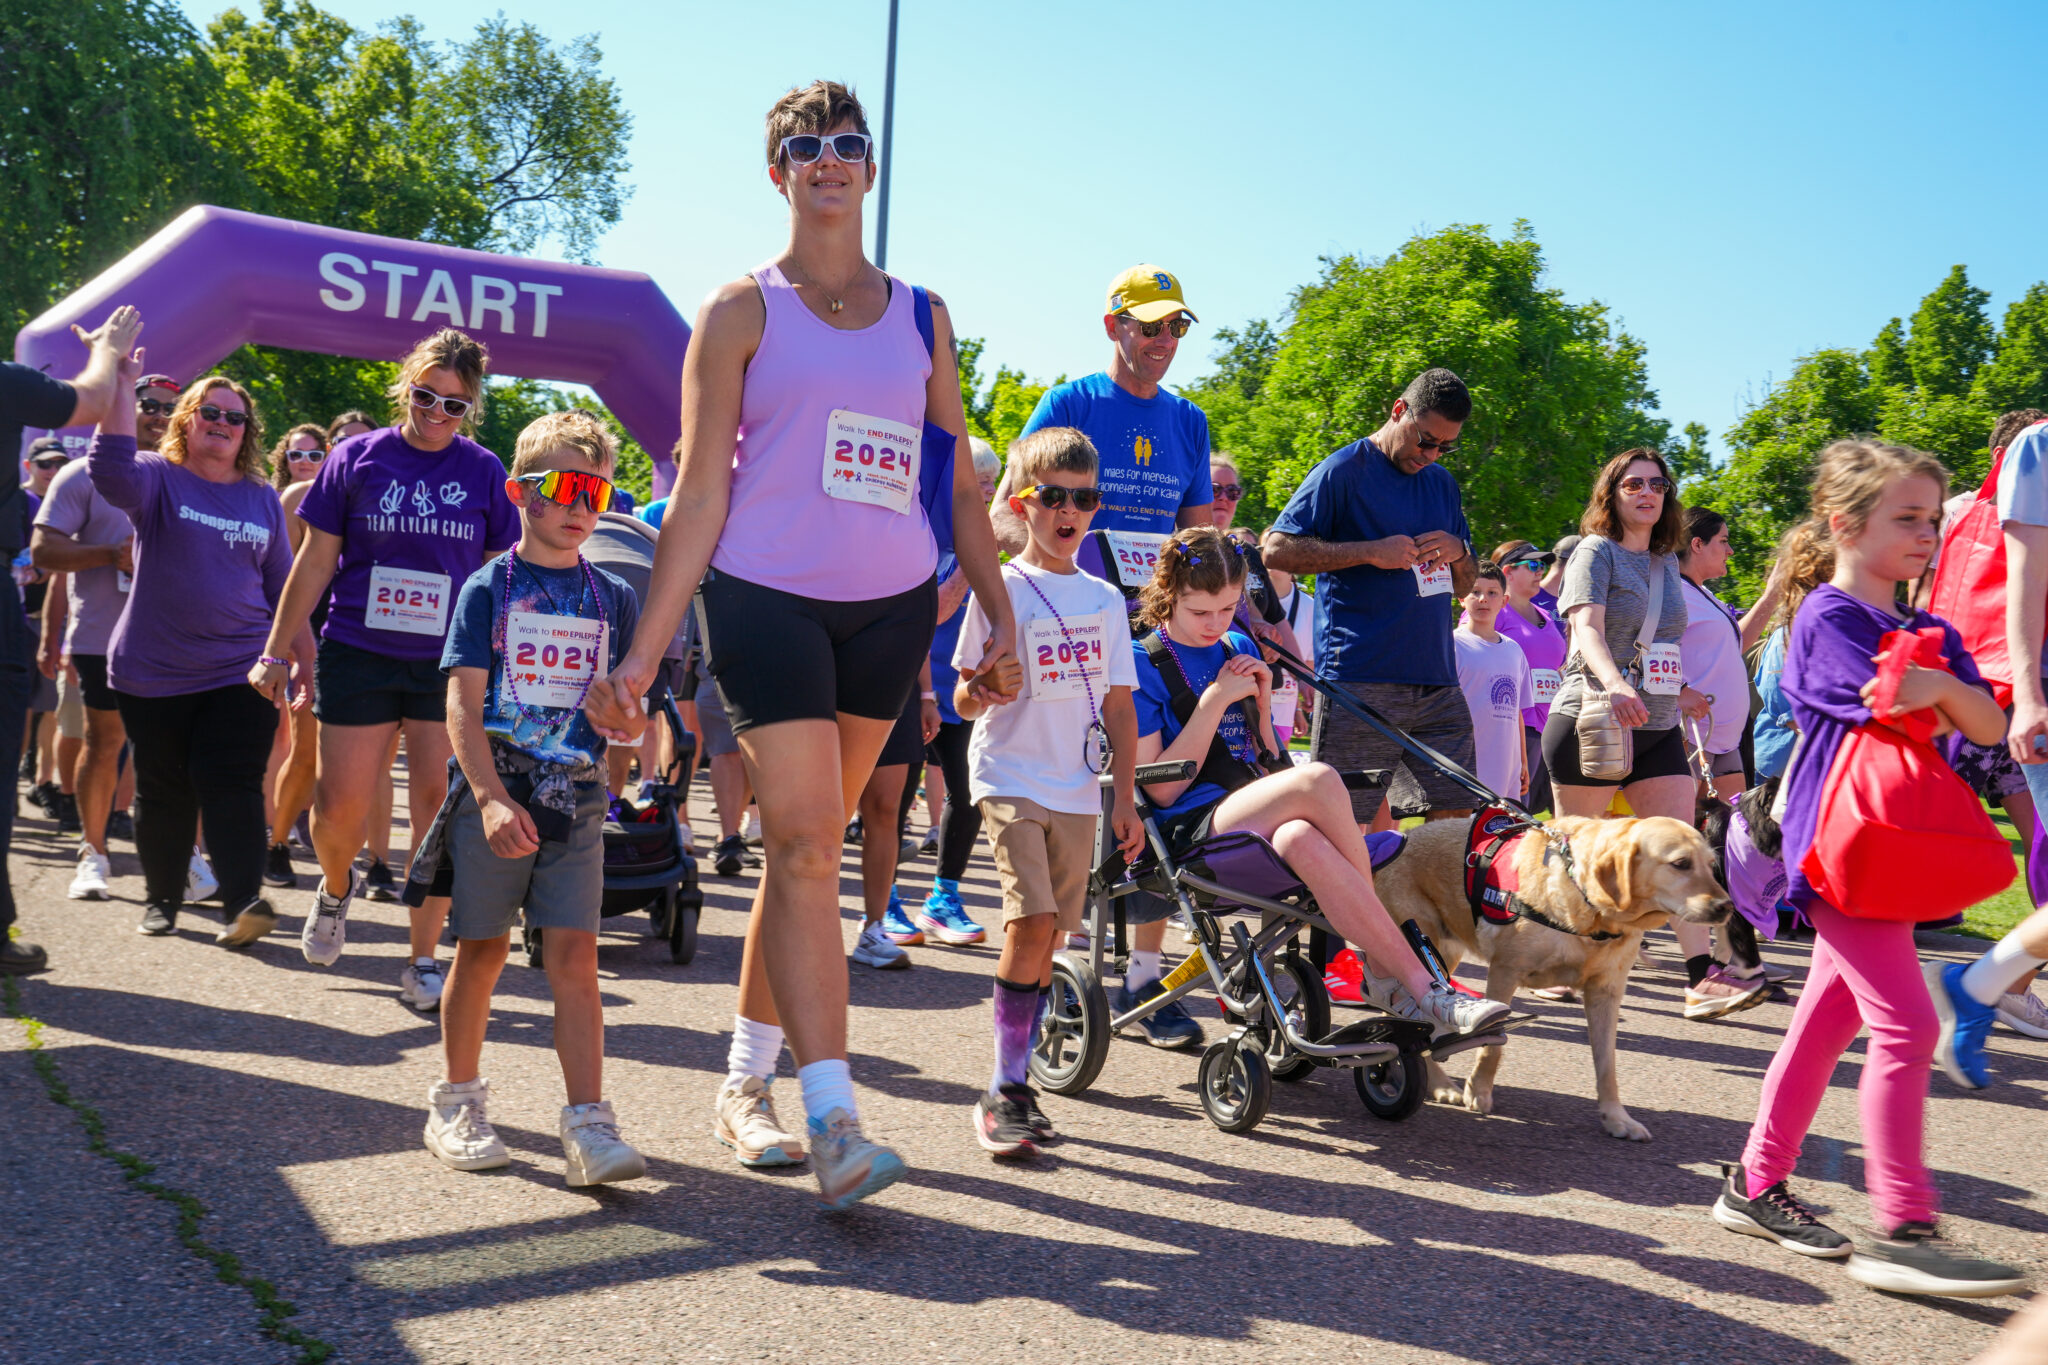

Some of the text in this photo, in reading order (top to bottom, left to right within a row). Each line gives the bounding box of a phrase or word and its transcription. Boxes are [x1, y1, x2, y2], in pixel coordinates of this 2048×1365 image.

[1153, 273, 1172, 291] B
[318, 252, 563, 338] START
[838, 423, 855, 433] Walk
[867, 429, 883, 438] END
[884, 433, 914, 447] EPILEPSY
[835, 440, 911, 476] 2024
[179, 505, 242, 532] Stronger
[1108, 504, 1126, 512] WALK
[1140, 507, 1154, 515] END
[366, 514, 474, 541] TEAM LYLAH GRACE
[223, 530, 269, 554] epilepsy
[1118, 548, 1157, 567] 202
[377, 587, 440, 609] 2024
[519, 626, 598, 640] Walk to END EPILEPSY
[1034, 630, 1051, 638] Walk
[1075, 626, 1100, 634] EPILEPSY
[516, 642, 598, 672] 2024
[1037, 639, 1101, 666] 2024
